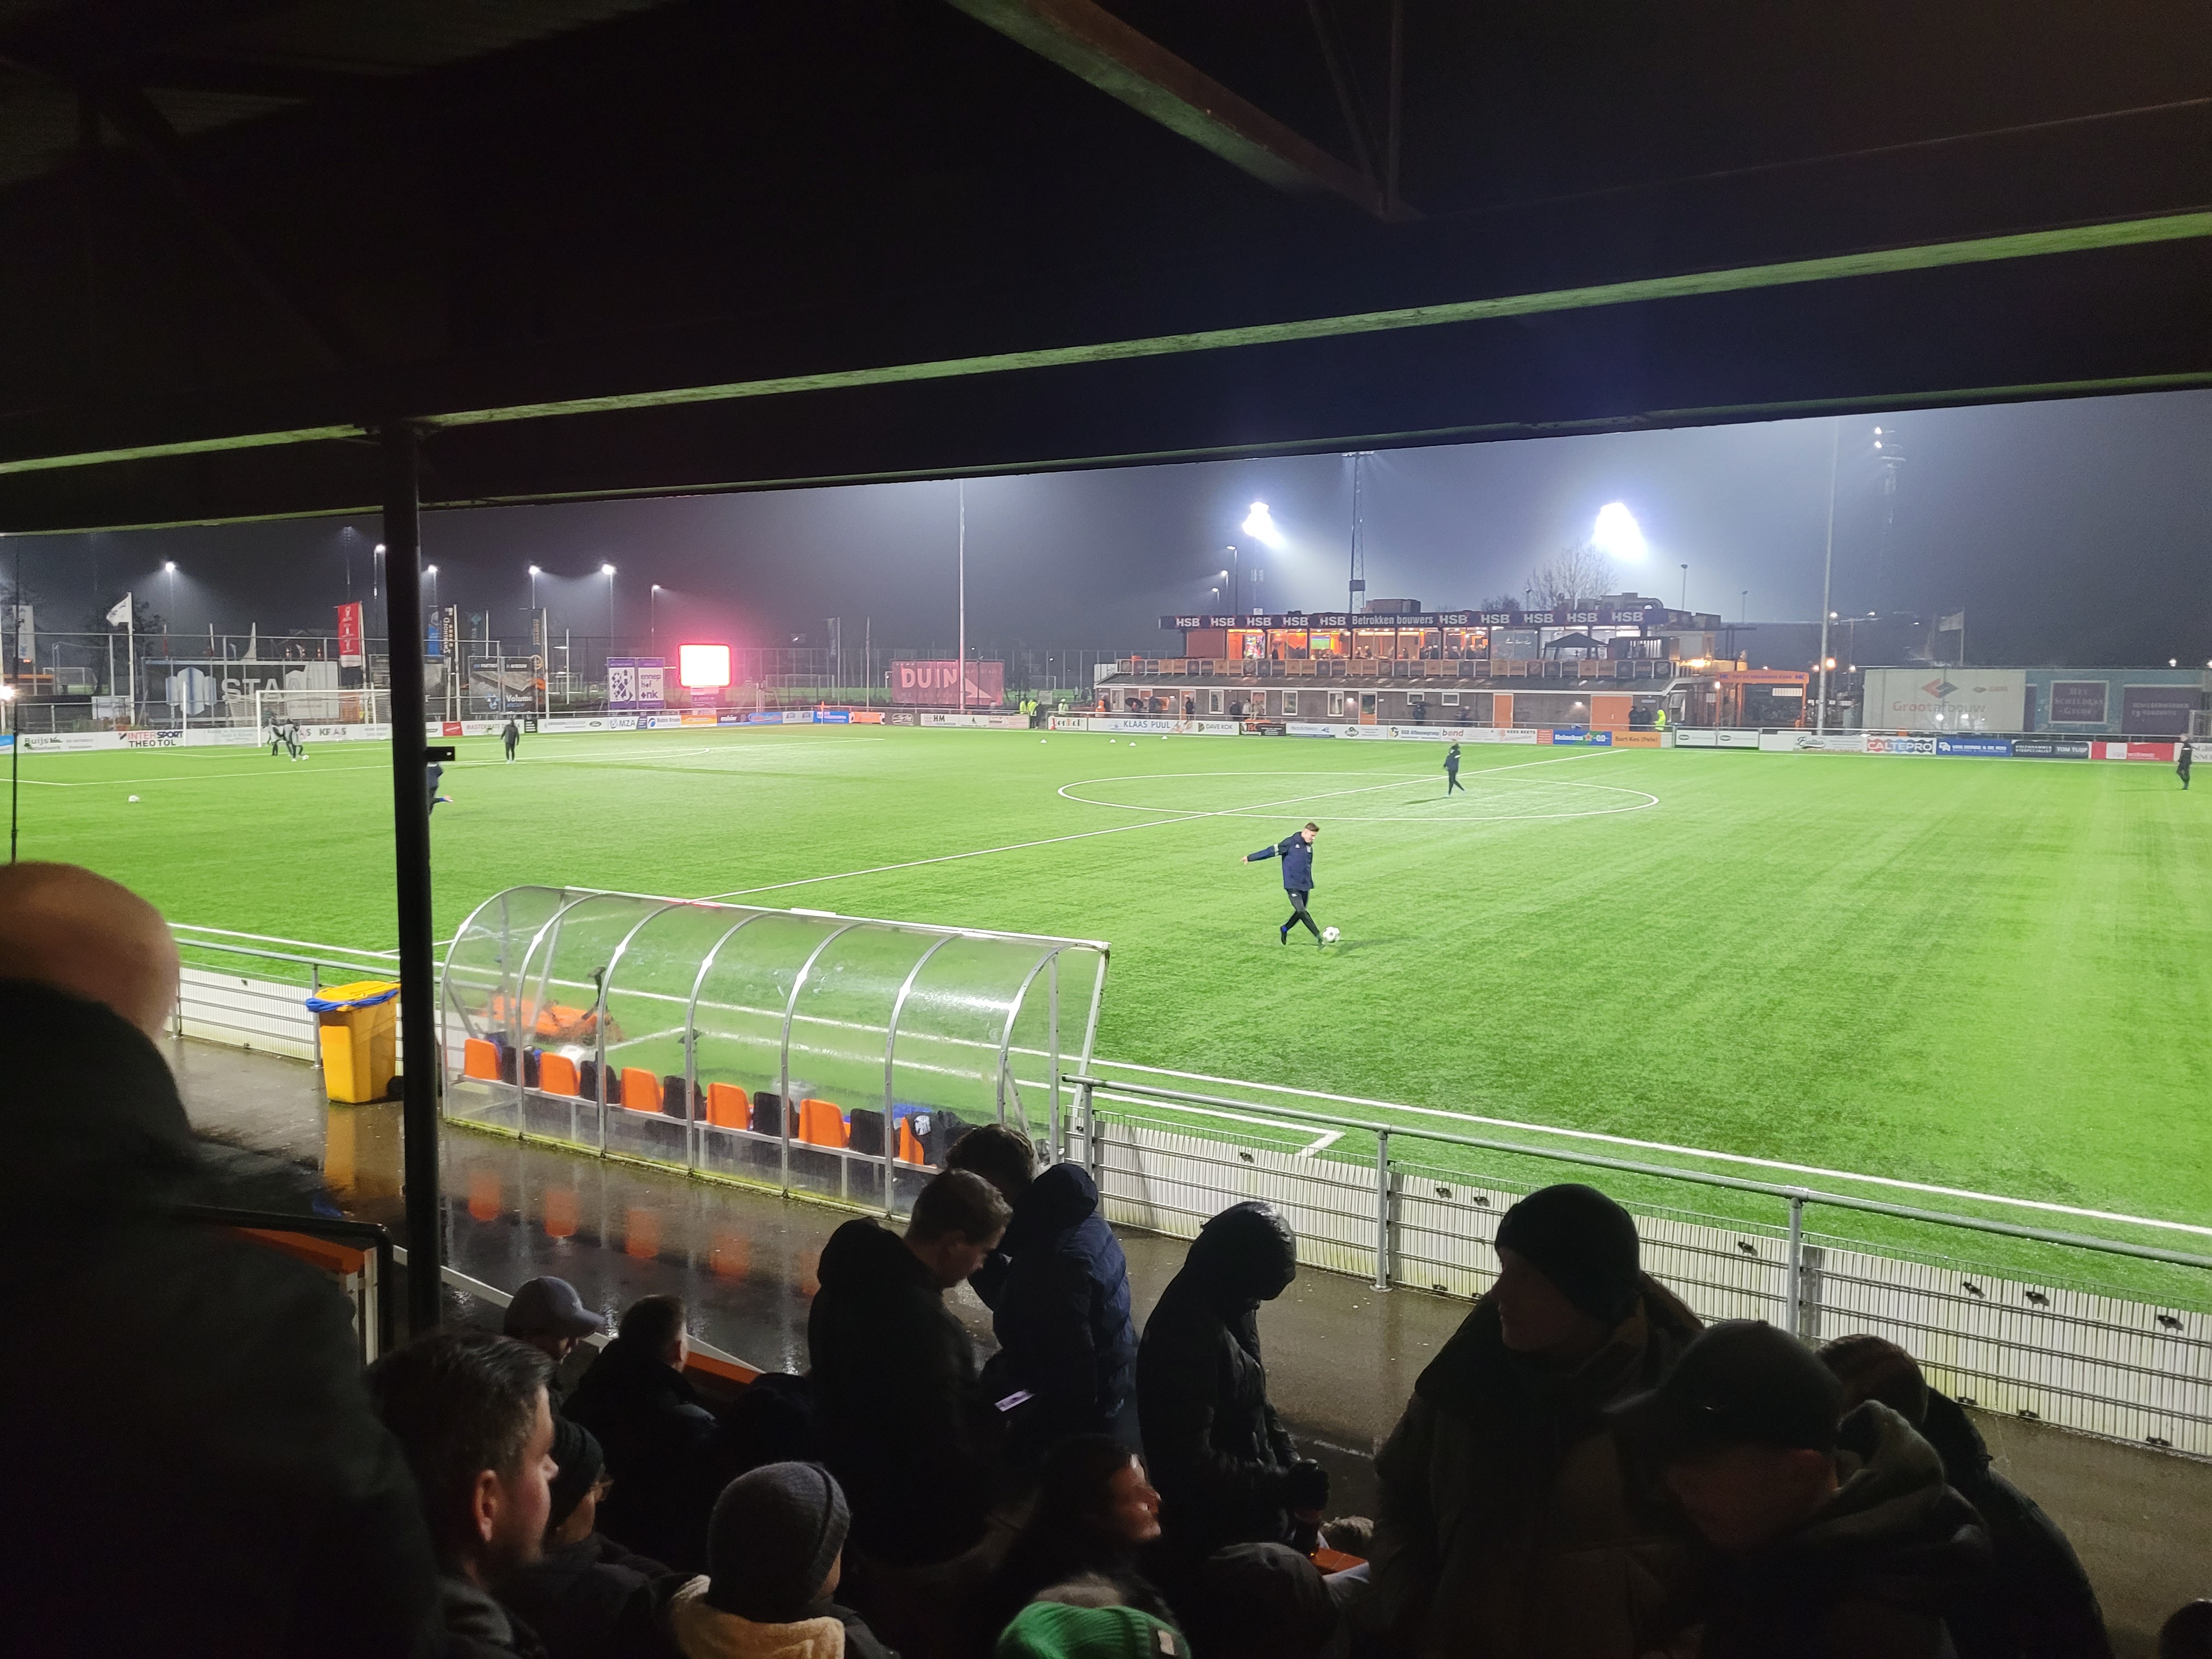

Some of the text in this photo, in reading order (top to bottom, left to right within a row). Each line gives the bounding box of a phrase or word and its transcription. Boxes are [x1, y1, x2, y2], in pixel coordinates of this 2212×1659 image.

[1283, 617, 1308, 626] HSB
[1320, 616, 1346, 626] HSB
[1352, 615, 1434, 625] Betrokken bouwers
[1440, 614, 1468, 624] HSB
[1481, 614, 1510, 624] HSB
[1524, 613, 1554, 624] HSB
[1567, 612, 1598, 623] HSB
[1612, 611, 1643, 622] HSB
[1177, 618, 1200, 627] HSB
[1211, 618, 1235, 627] HSB
[1247, 617, 1272, 627] HSB
[902, 668, 957, 688] DUIN
[1893, 701, 1985, 713] Grootafbouw
[25, 737, 49, 745] Buijs
[1867, 742, 1933, 751] CALTEPRO
